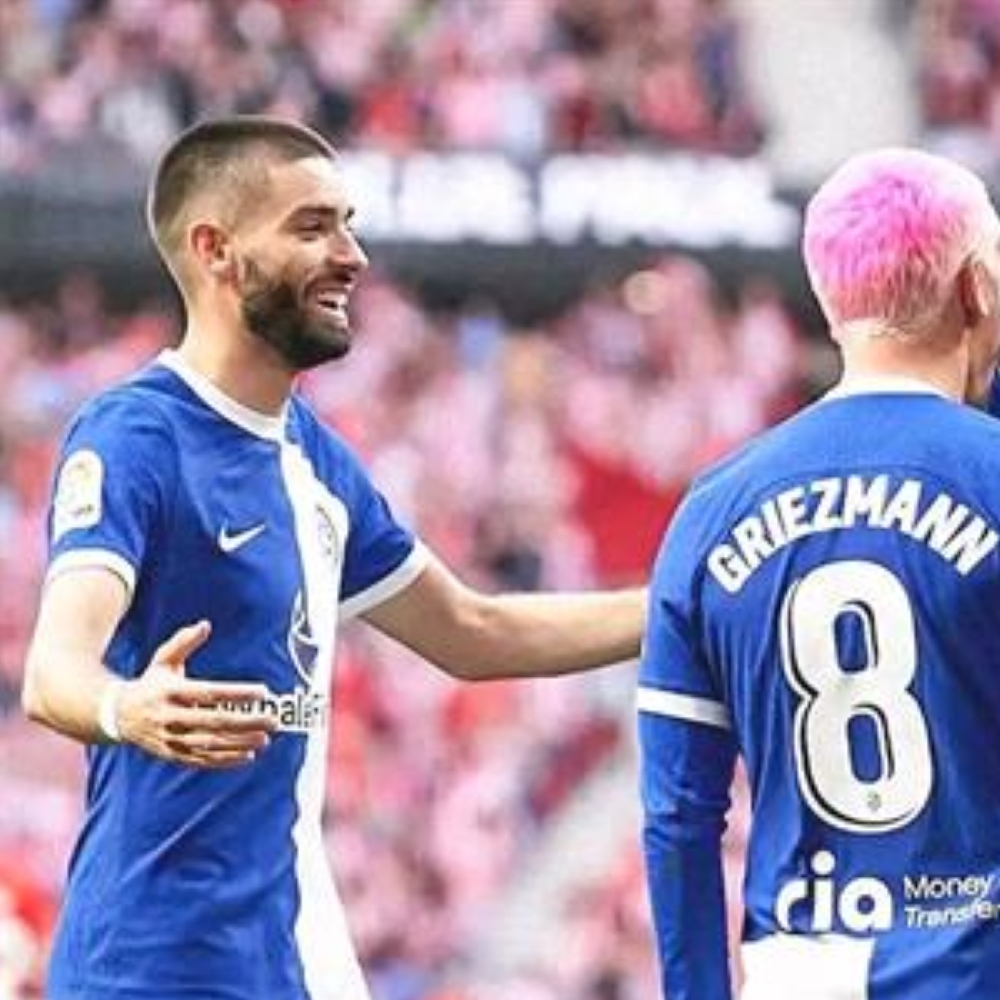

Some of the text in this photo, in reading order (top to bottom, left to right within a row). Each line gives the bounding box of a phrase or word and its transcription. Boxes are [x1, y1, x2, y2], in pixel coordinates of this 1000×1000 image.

[707, 475, 999, 593] GRIEZMANN
[780, 560, 934, 835] 8
[903, 874, 996, 900] Money
